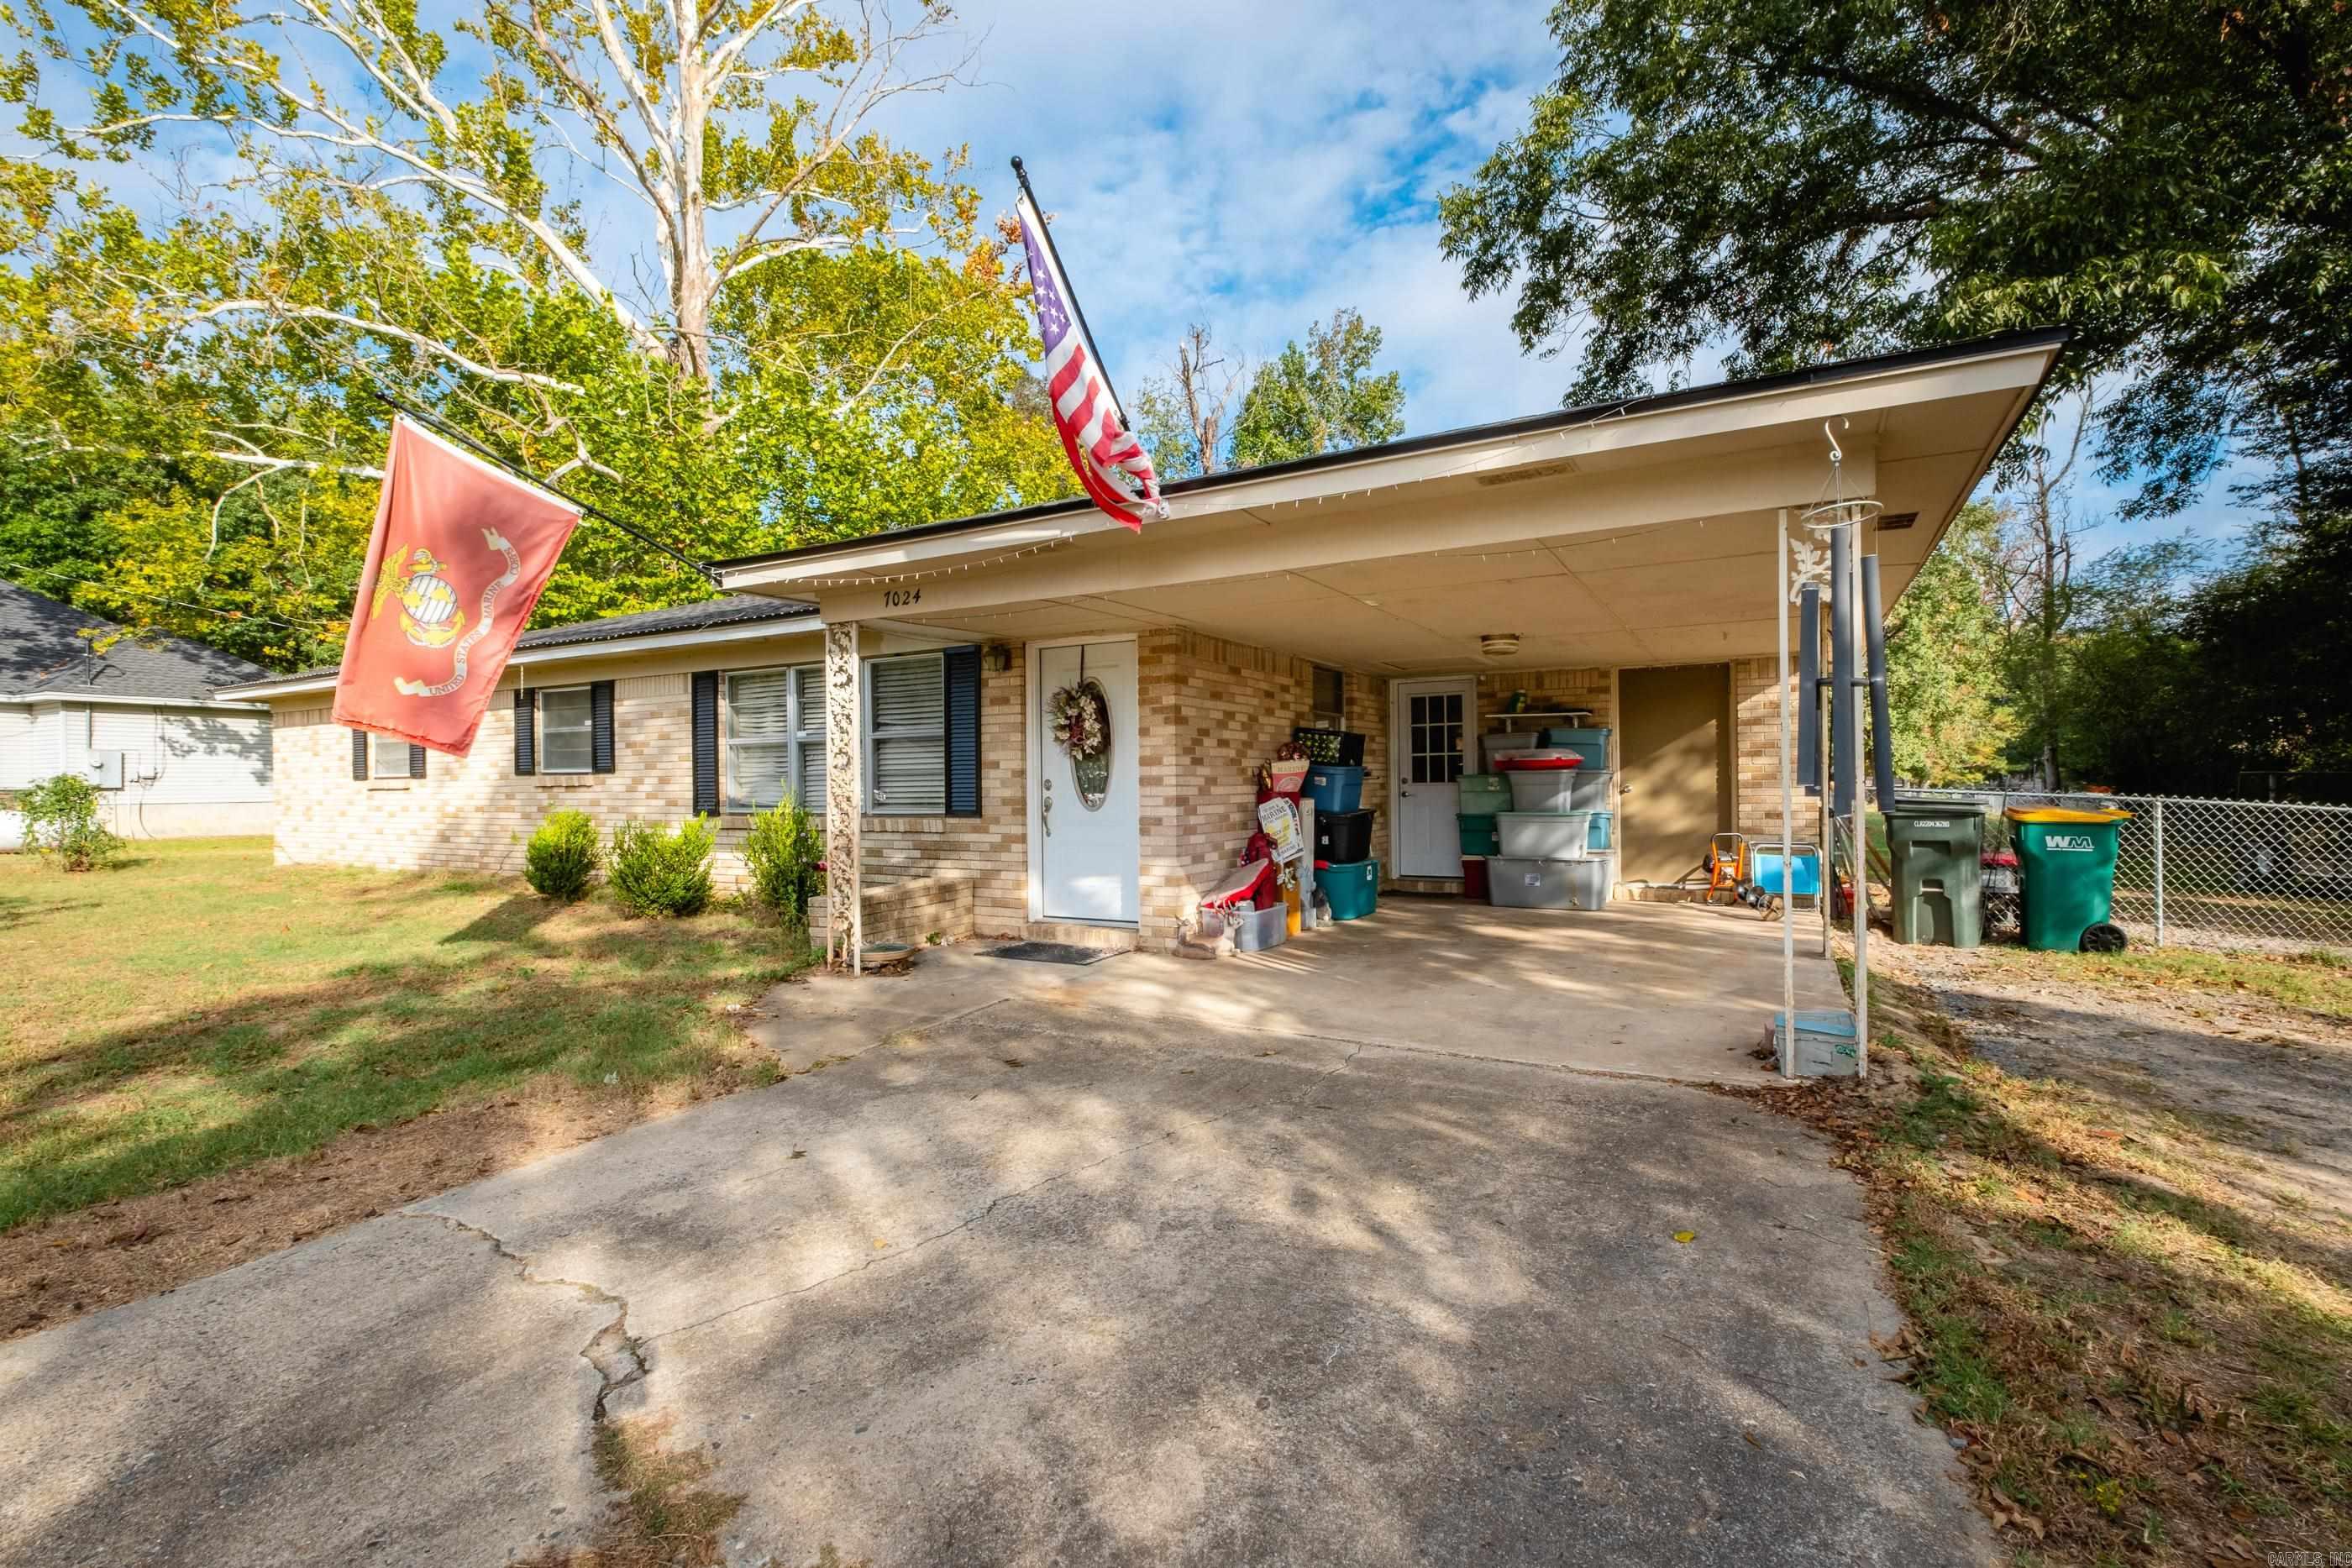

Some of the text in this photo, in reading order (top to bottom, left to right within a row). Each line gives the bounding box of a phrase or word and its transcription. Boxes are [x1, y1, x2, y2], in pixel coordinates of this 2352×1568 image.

[456, 630, 482, 664] STATES
[484, 580, 505, 621] MARINE
[506, 547, 520, 575] CORPS
[884, 588, 921, 608] 7024
[2045, 836, 2095, 848] WM
